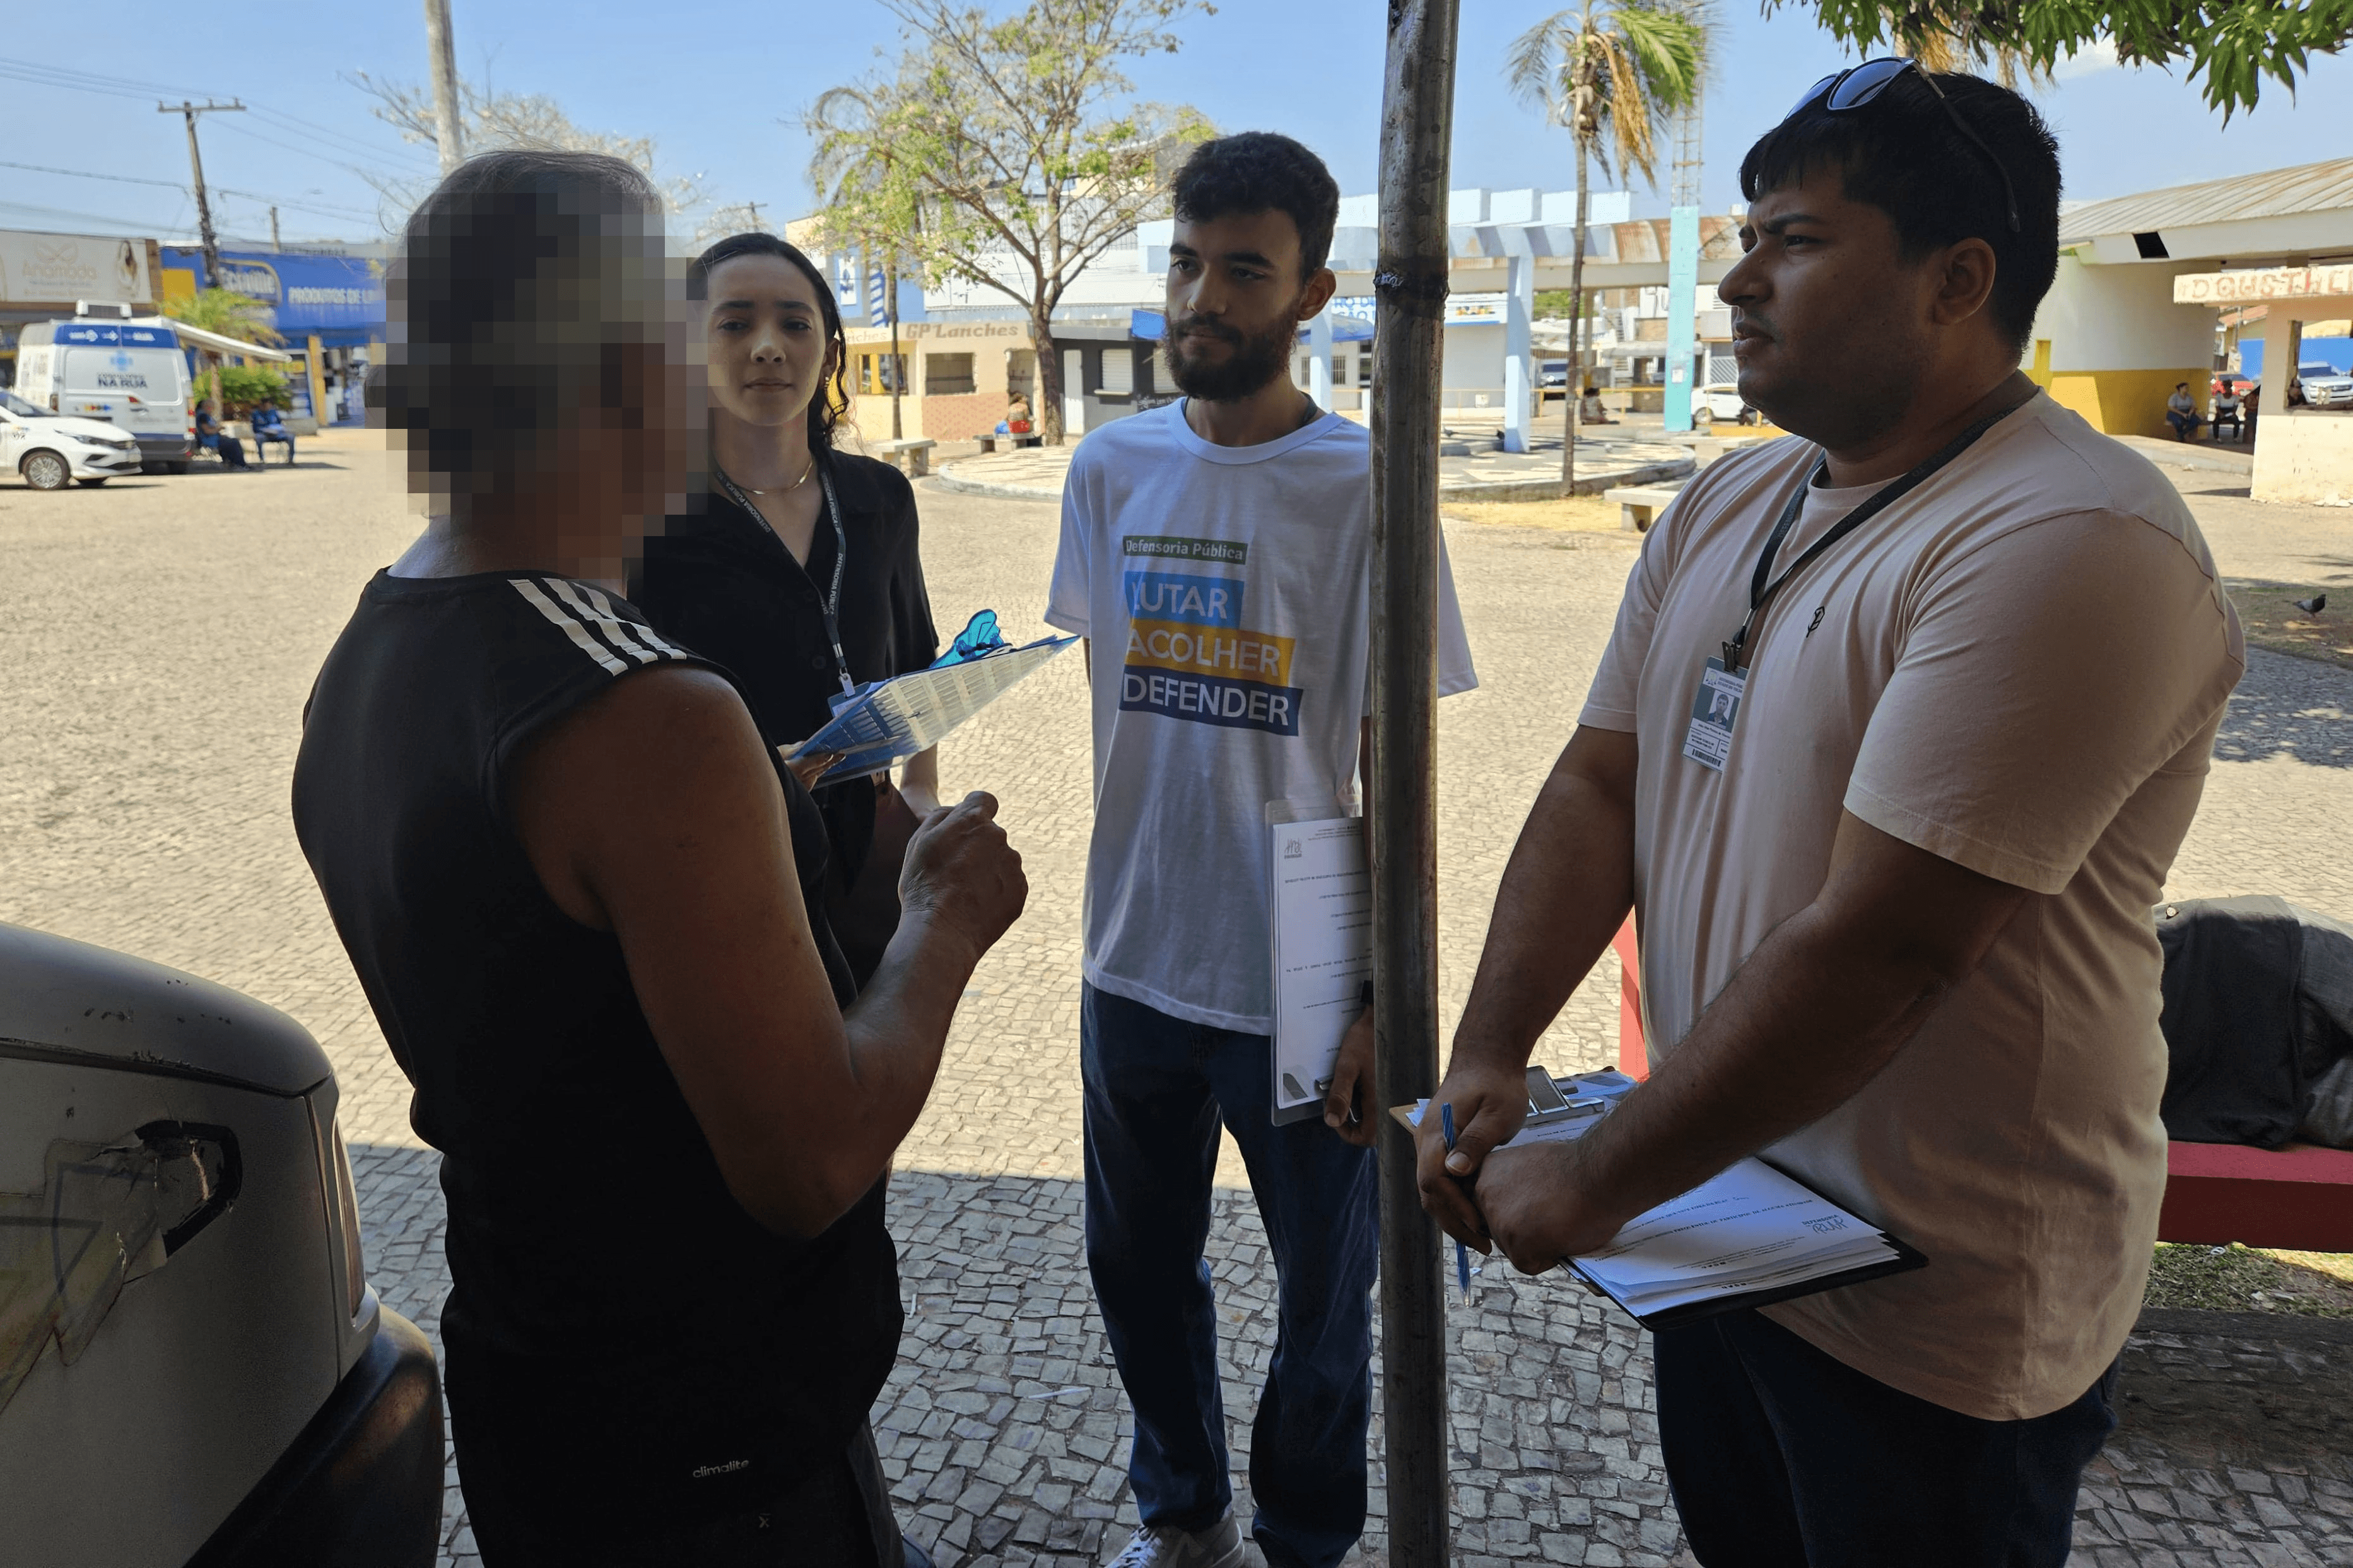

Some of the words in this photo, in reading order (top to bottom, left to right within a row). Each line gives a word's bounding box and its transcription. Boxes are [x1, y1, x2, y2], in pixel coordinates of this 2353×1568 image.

[905, 323, 930, 339] GP
[931, 322, 1019, 339] Lanches
[97, 378, 118, 388] NA
[120, 379, 148, 389] RUA
[1125, 537, 1188, 556] Defensoria
[1192, 542, 1244, 561] Pública
[831, 552, 843, 590] DEFENSORIA
[1126, 627, 1281, 677] ACOLHER
[1122, 673, 1289, 726] DEFENDER
[692, 1460, 750, 1478] climalite
